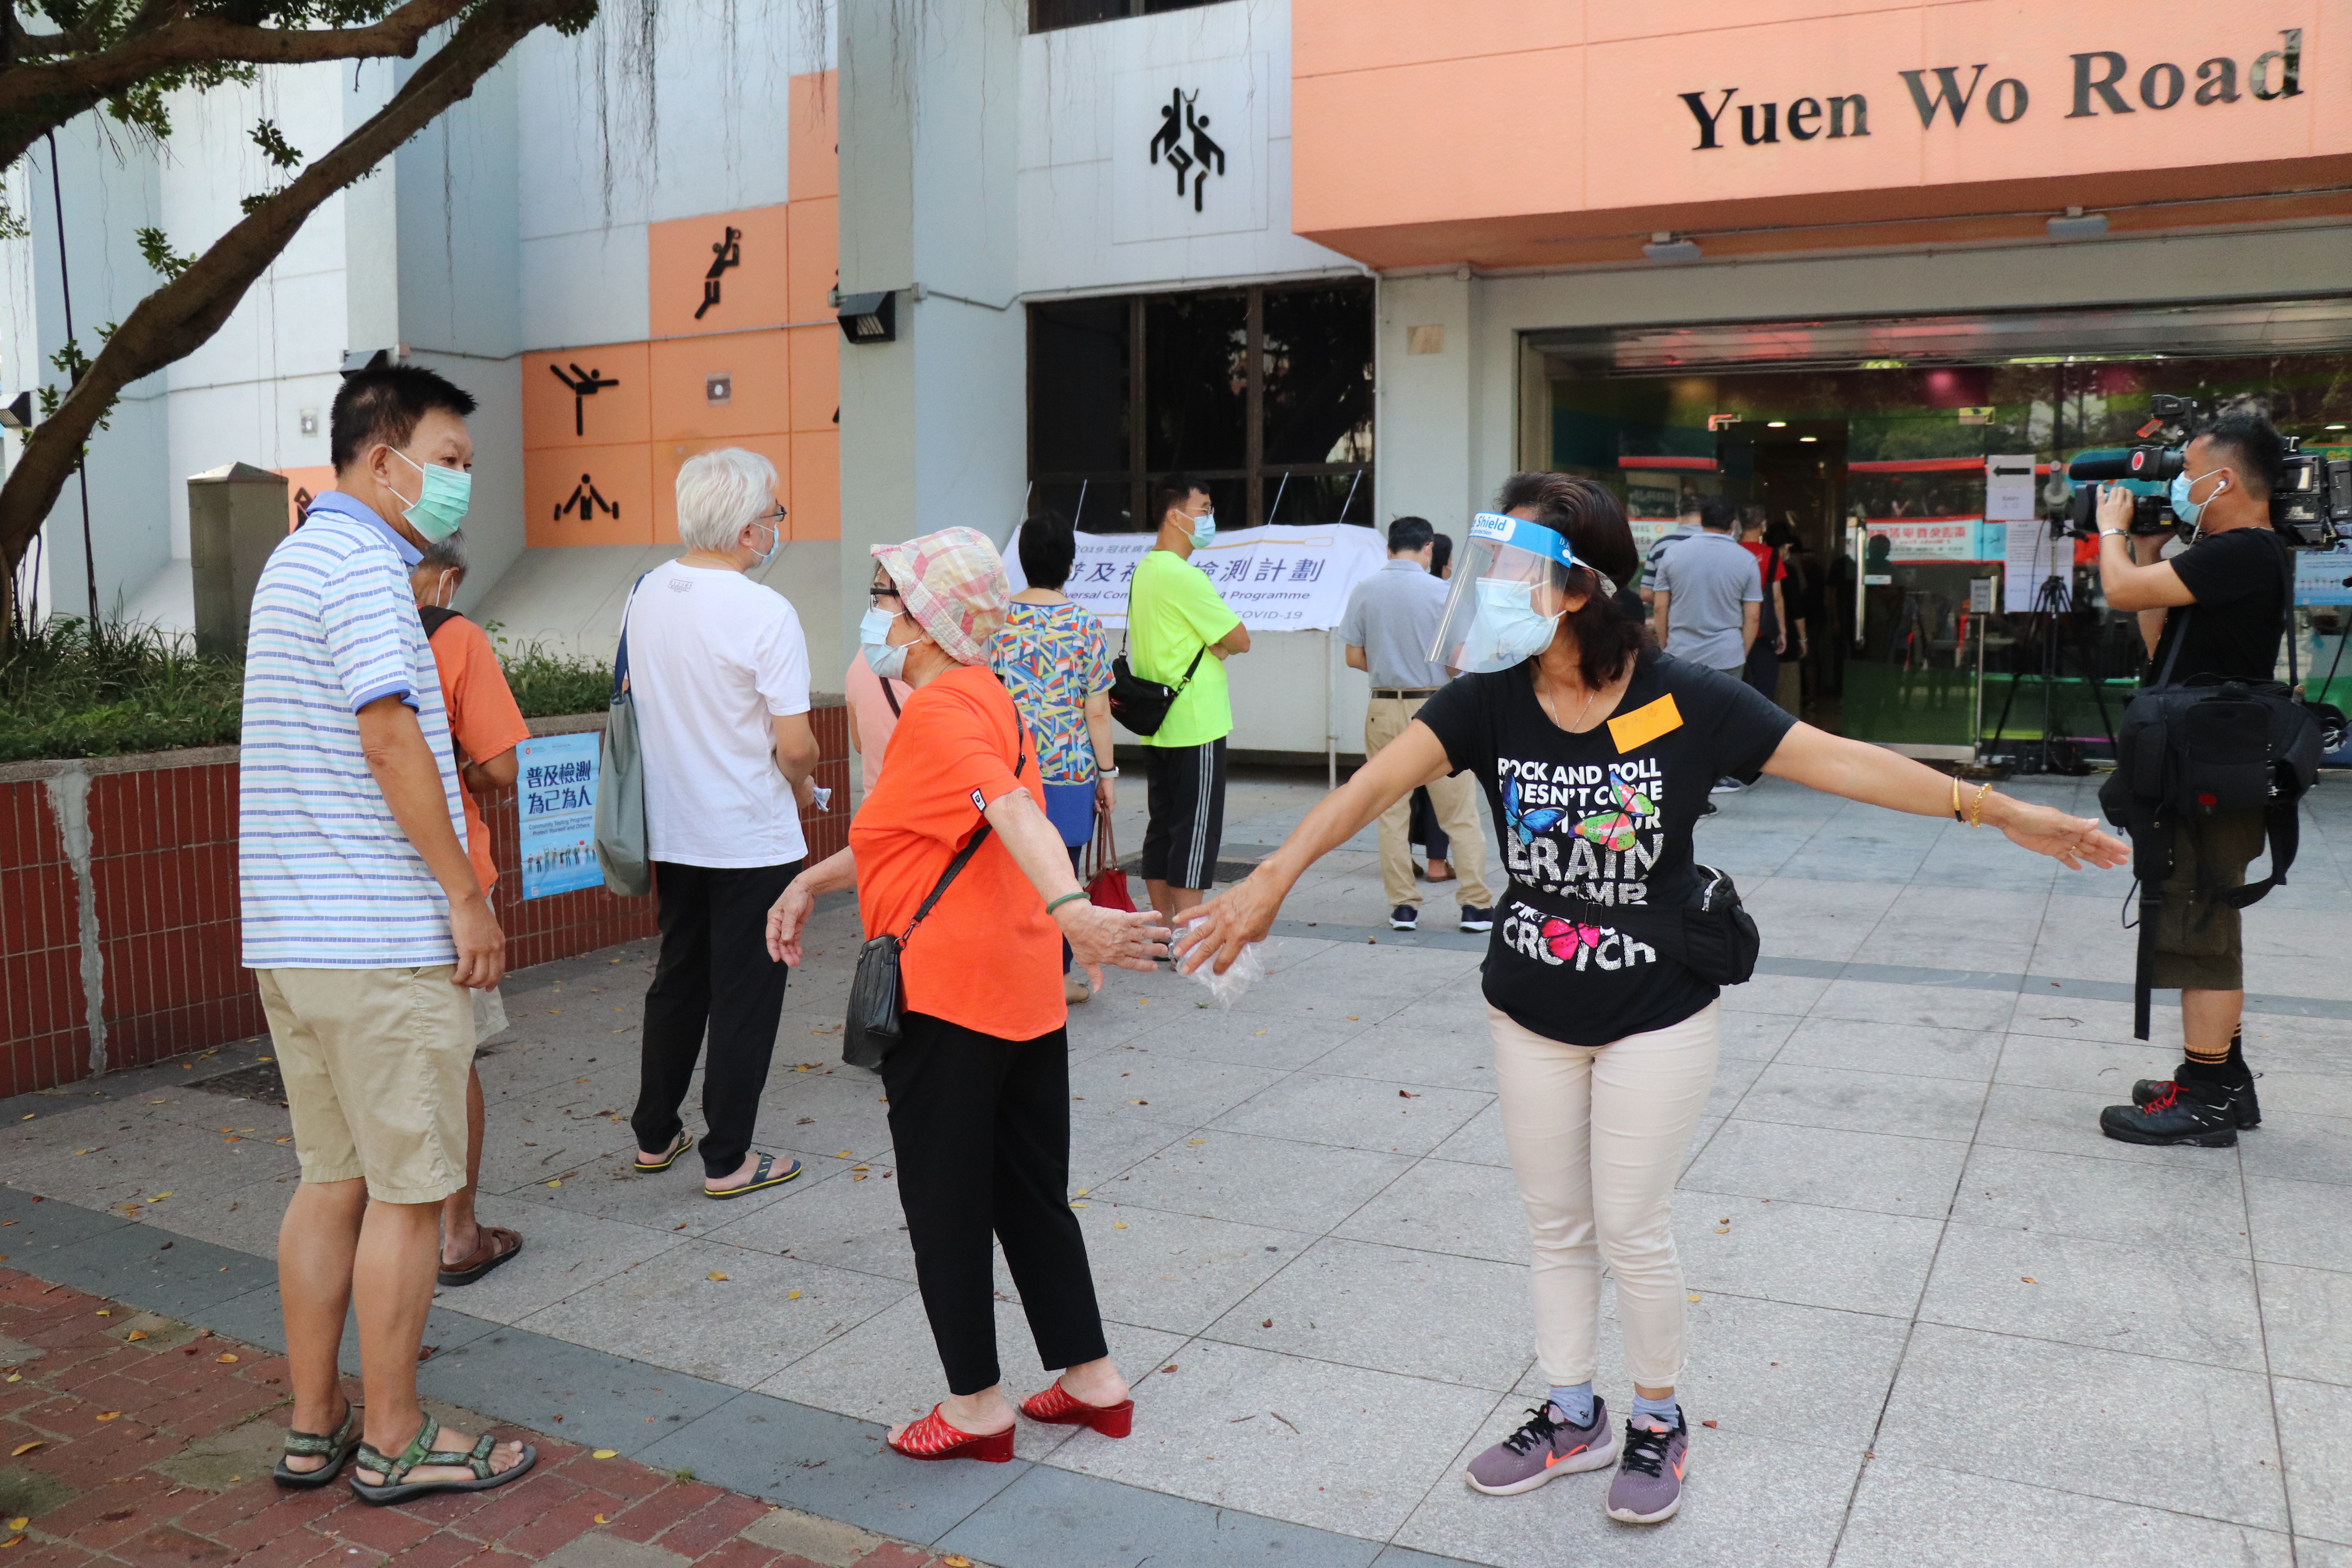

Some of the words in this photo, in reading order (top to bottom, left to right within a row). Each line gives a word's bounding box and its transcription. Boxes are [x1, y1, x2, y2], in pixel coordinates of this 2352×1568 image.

[1678, 87, 1871, 151] Yuen
[1898, 63, 2029, 131] Wo
[2064, 27, 2305, 120] Road
[1476, 515, 1507, 532] Shield
[1075, 544, 1103, 553] 2019
[1230, 591, 1310, 601] Programme
[526, 760, 591, 789] 普及檢測
[1497, 757, 1548, 781] ROCK
[1552, 766, 1602, 785] AND
[528, 785, 592, 814] 為己為人
[1499, 780, 1591, 807] ESN'T
[529, 822, 554, 830] Community
